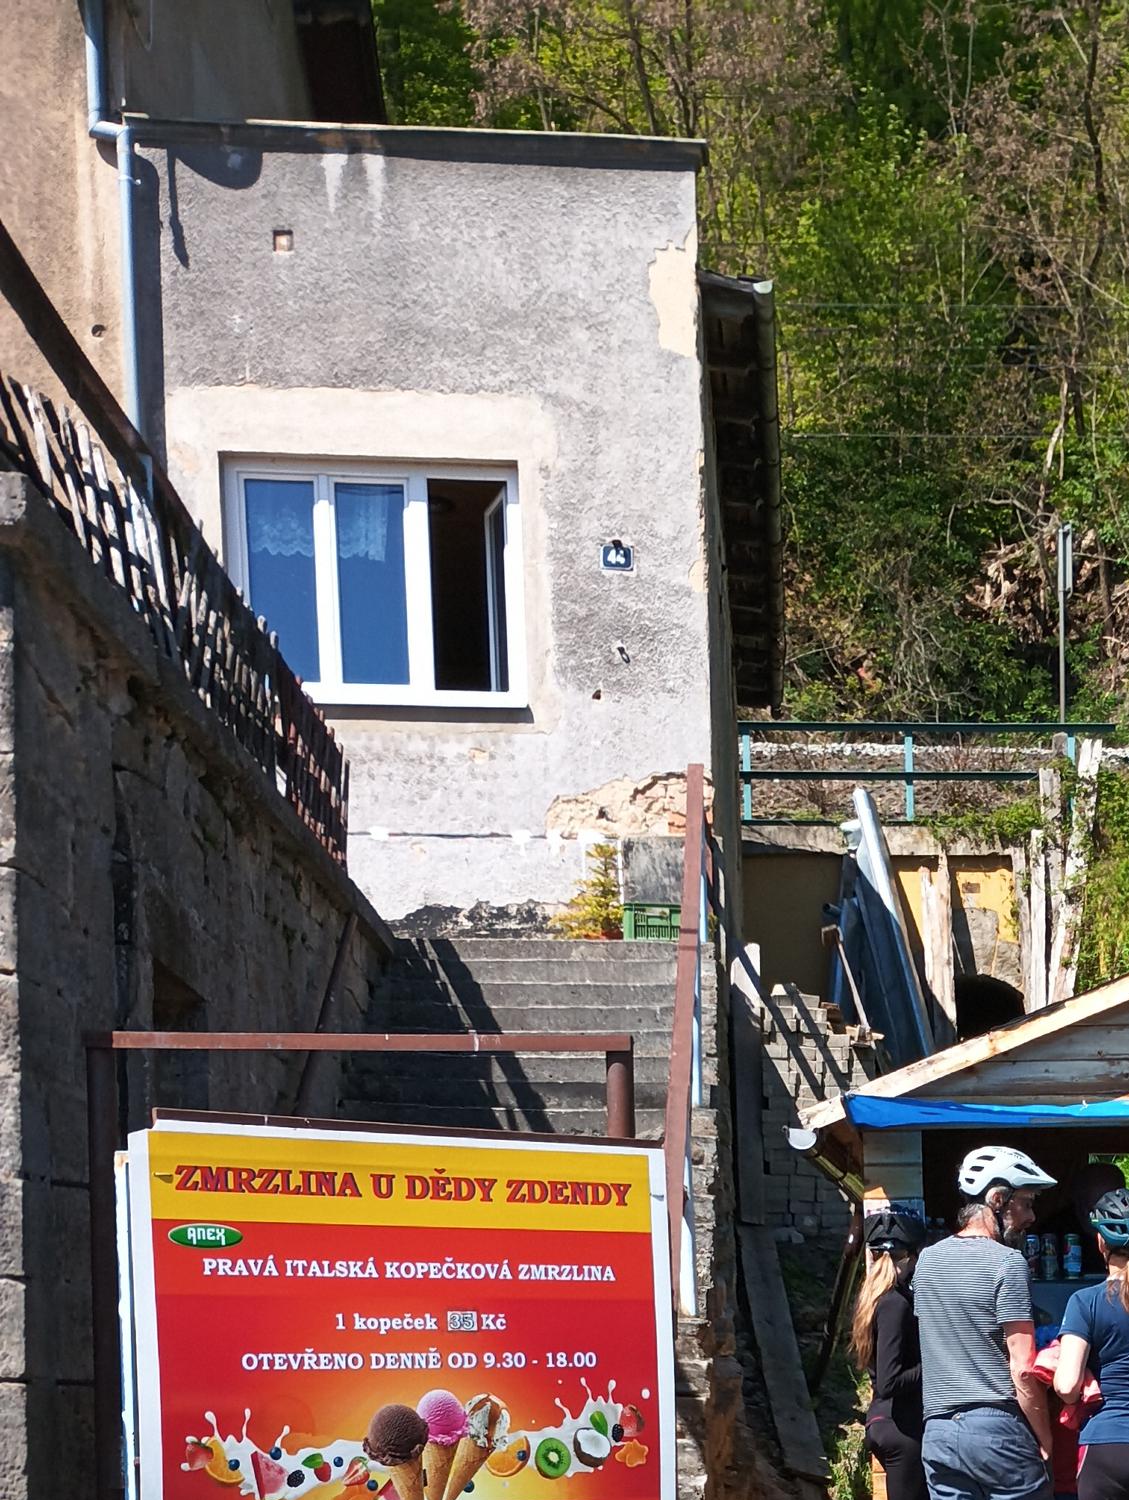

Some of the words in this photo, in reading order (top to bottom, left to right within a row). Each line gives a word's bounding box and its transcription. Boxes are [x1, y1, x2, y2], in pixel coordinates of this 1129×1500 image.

[175, 1165, 362, 1198] ZMRZLINA
[370, 1173, 395, 1199] U
[405, 1168, 497, 1203] DĚDY
[506, 1179, 632, 1206] ZDENDY
[203, 1254, 279, 1276] PRAVÁ
[285, 1257, 379, 1279] ITALSKÁ
[385, 1256, 513, 1281] KOPEČKOVÁ
[518, 1263, 616, 1281] ZMRZLINA
[335, 1313, 346, 1330] 1
[353, 1313, 438, 1334] kopeček
[449, 1314, 475, 1329] 35
[480, 1313, 506, 1330] Kč
[241, 1348, 363, 1370] OTEVŘENO
[370, 1348, 441, 1369] DENNĚ
[447, 1353, 477, 1369] OD
[483, 1352, 526, 1368] 9.30
[545, 1352, 597, 1368] 18.00
